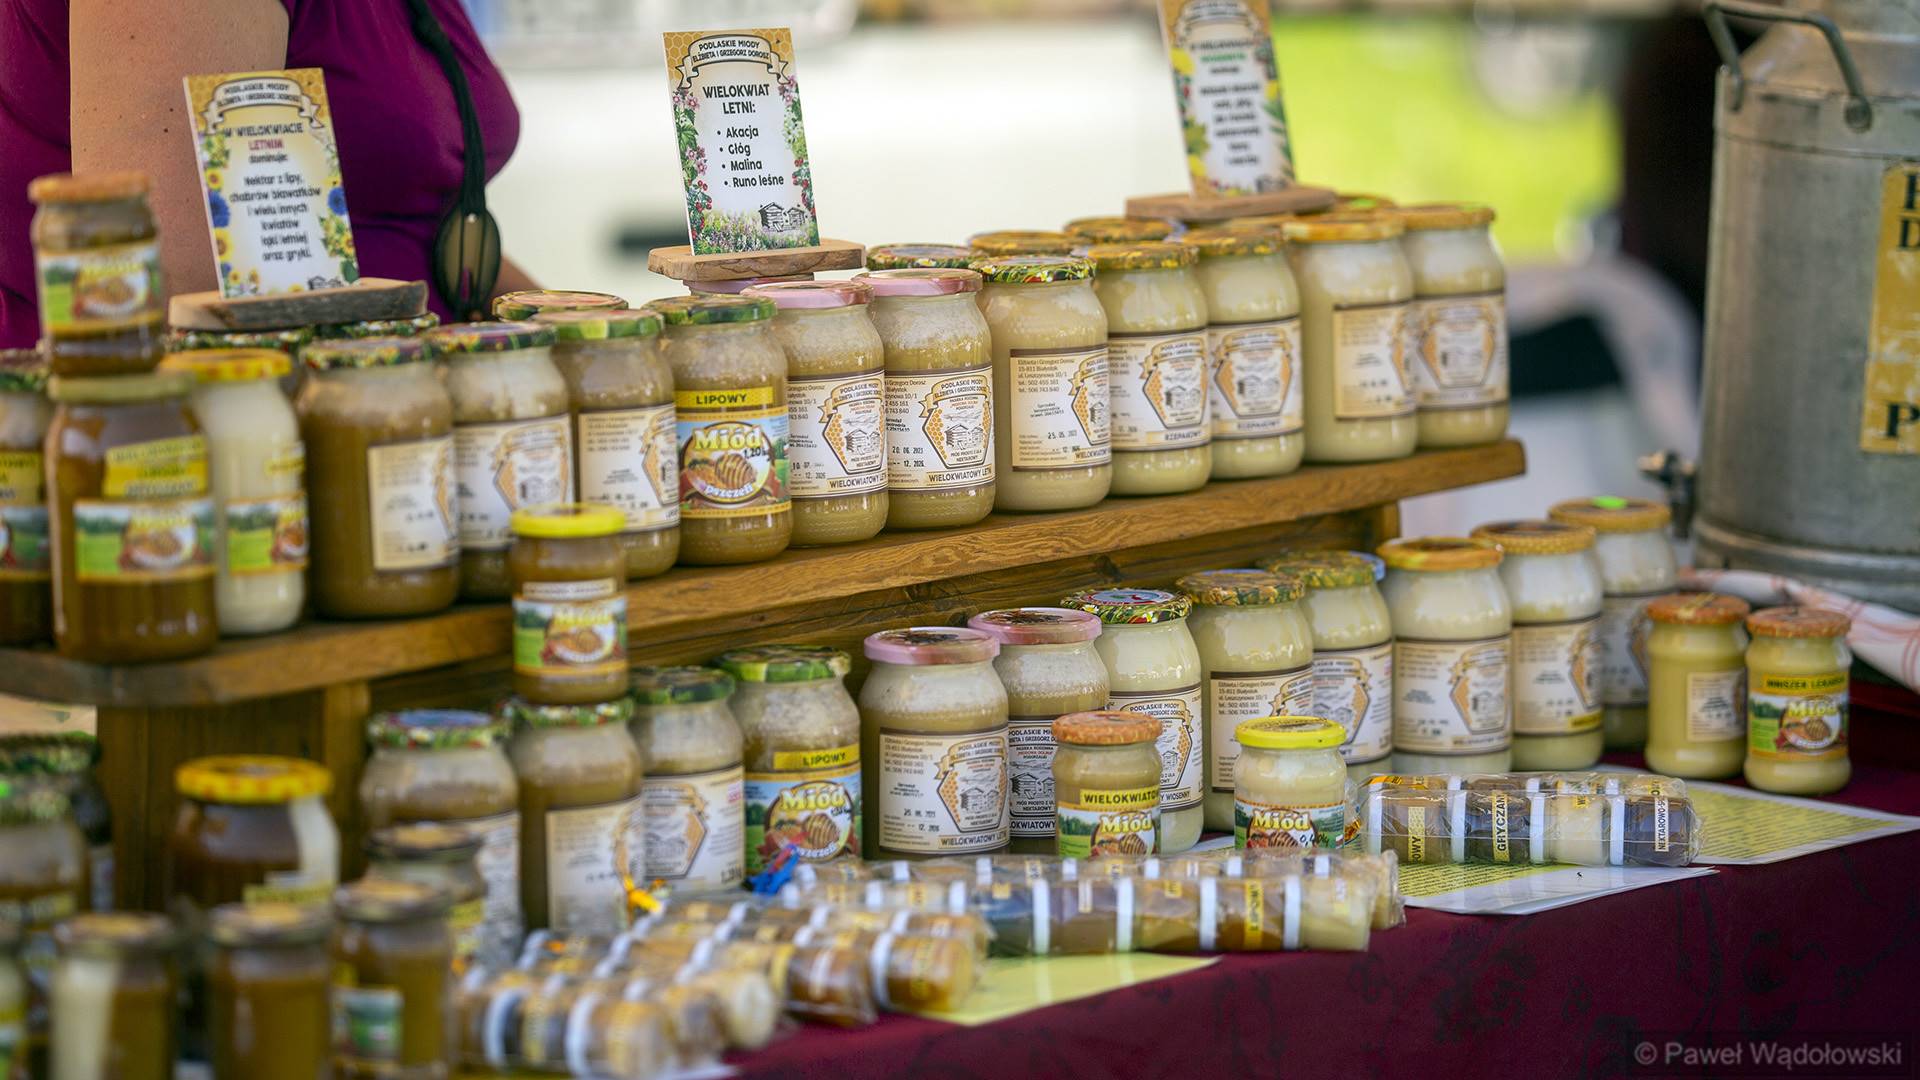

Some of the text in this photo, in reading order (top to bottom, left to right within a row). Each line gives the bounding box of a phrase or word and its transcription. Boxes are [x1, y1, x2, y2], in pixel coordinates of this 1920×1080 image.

[699, 40, 760, 51] PODLASKIE MIODY
[692, 51, 716, 62] ELŻBIETA
[748, 50, 770, 60] DOROSZ
[702, 84, 770, 98] WIELOKWIAT
[723, 101, 756, 114] LETNI:
[236, 122, 304, 137] WIELOKWIACIE
[726, 125, 759, 140] Akacja
[728, 142, 751, 157] Głóg
[730, 158, 762, 171] Malina
[244, 175, 275, 186] Nektar
[733, 173, 784, 188] Runo leśne
[229, 191, 268, 202] chabrów
[254, 206, 276, 216] wielu
[279, 203, 308, 215] innych
[261, 219, 299, 230] kwiatów
[262, 251, 284, 261] oraz
[941, 381, 970, 390] PODLASKIE
[696, 393, 748, 405] LIPOWY
[692, 424, 764, 451] Miód
[829, 475, 878, 489] WIELOKWIATOWY
[929, 470, 981, 482] WIELOKWIATOWY
[1130, 703, 1162, 712] PODLASKIE
[802, 752, 845, 766] LIPOWY
[778, 783, 845, 811] Miód
[1166, 791, 1190, 800] WIOSENNY
[1100, 810, 1153, 834] Miód
[1253, 809, 1311, 831] Miód
[940, 833, 995, 847] WIELOKWIATOWY
